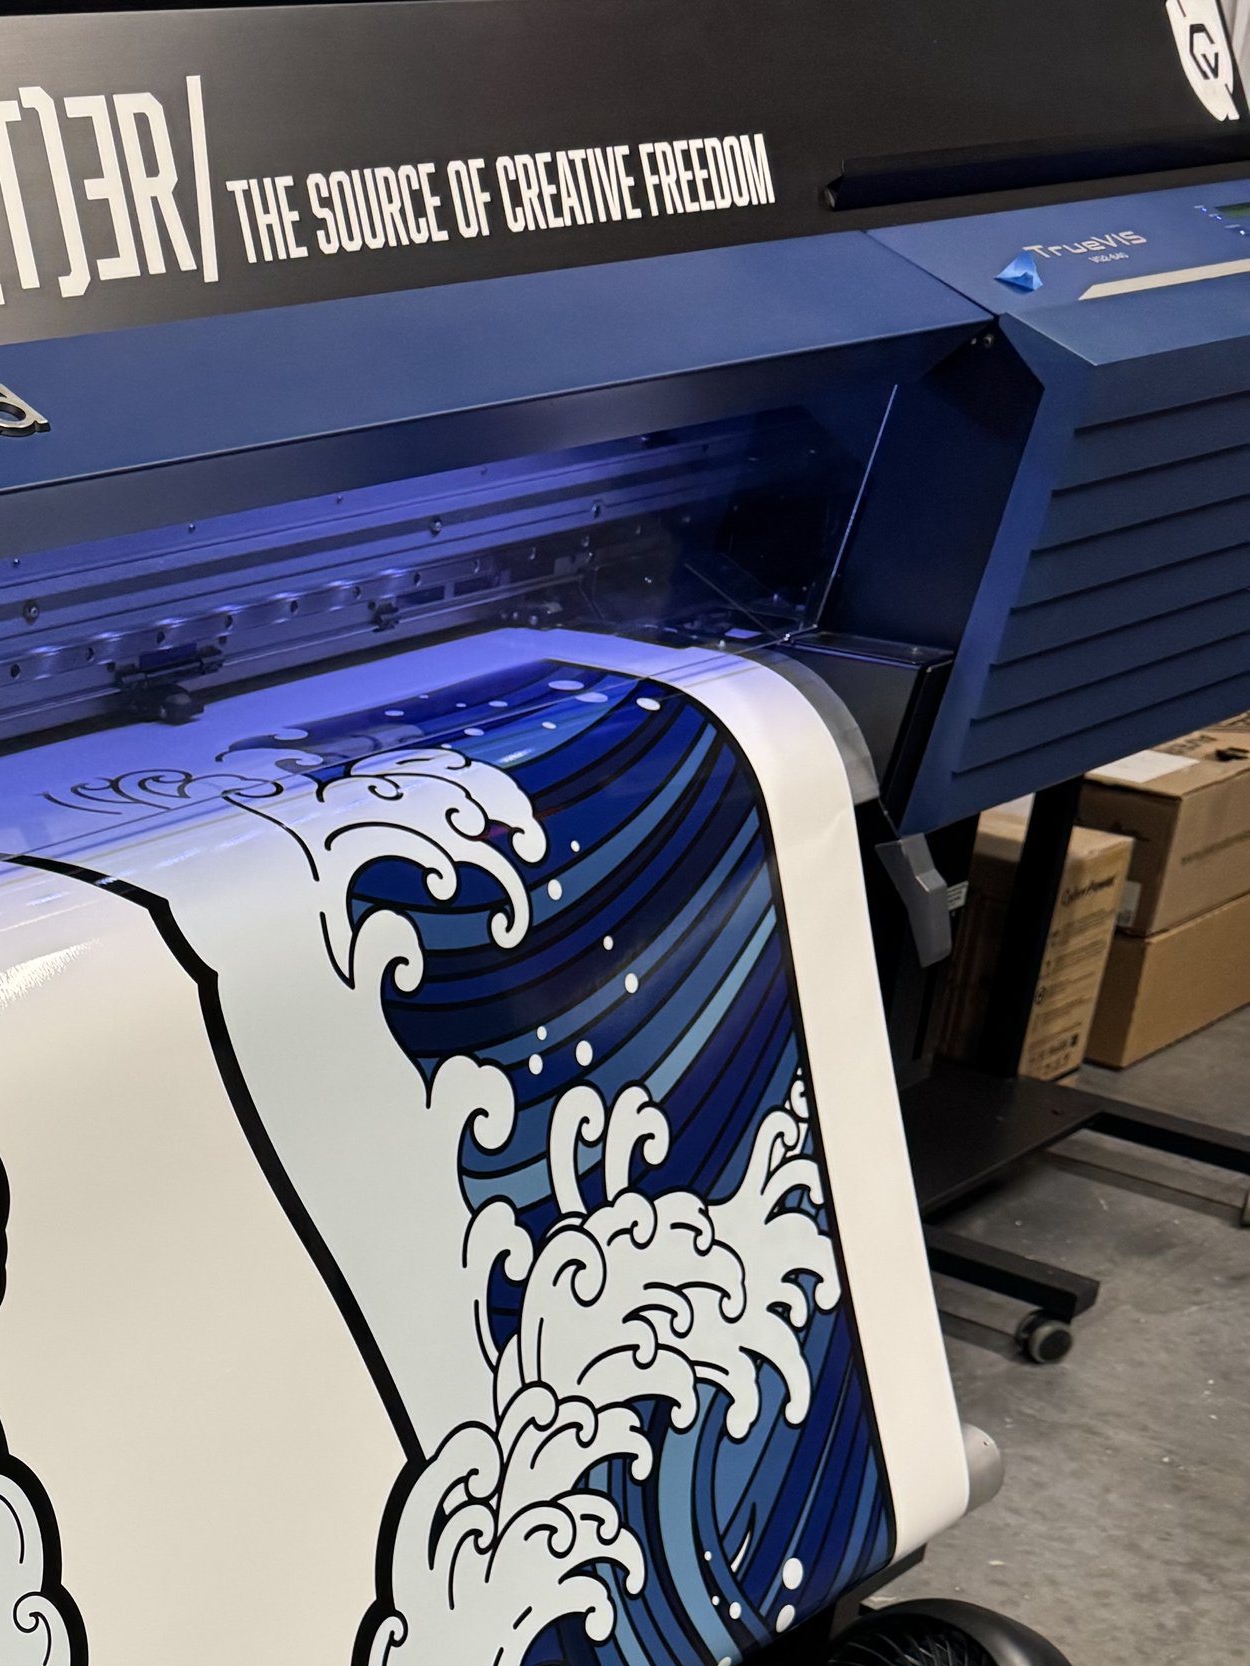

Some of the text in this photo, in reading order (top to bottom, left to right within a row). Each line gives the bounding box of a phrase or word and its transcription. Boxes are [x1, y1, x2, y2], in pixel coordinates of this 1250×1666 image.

[225, 175, 309, 264] THE
[306, 162, 449, 255] SOURCE
[446, 158, 491, 239] OF
[495, 144, 642, 233] CREATIVE
[638, 133, 776, 217] FREEDOM
[1022, 230, 1147, 258] TrueVIS
